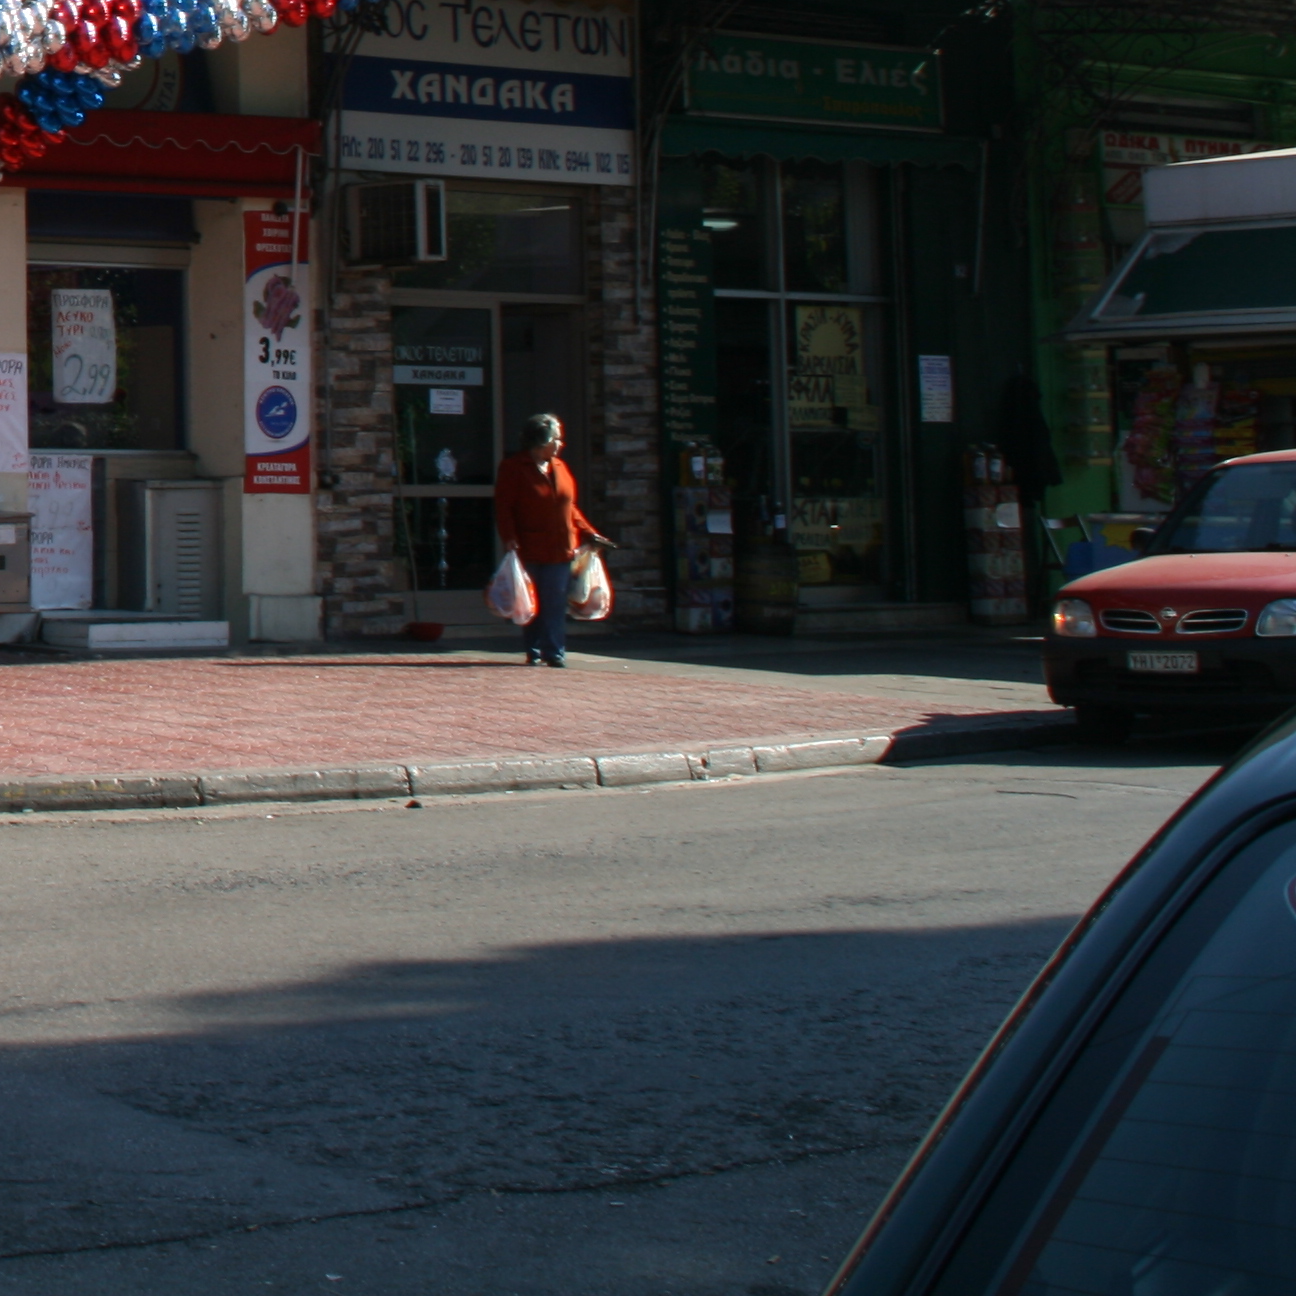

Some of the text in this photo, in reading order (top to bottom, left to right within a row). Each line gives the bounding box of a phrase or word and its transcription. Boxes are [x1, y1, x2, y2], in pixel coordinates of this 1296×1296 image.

[439, 2, 626, 56] ΤΕΛΕΤΩΝ
[698, 46, 800, 79] Λάδια
[836, 58, 928, 95] Ελιές
[390, 69, 576, 113] ΧΑΝΔΑΚΑ
[338, 135, 362, 158] ΗΛ:
[368, 137, 384, 159] 210
[391, 139, 400, 161] 51
[407, 140, 419, 162] 22
[425, 141, 445, 163] 296
[460, 144, 477, 165] 210
[482, 146, 492, 167] 51
[498, 146, 511, 167] 20
[517, 147, 533, 169] 139
[566, 150, 590, 172] 6944
[596, 151, 611, 173] 102
[1104, 133, 1242, 154] ΩΔΙΚΑ ΠΤΗΝΑ
[53, 294, 109, 308] ΠΡΟΣΦΟΡΑ
[56, 311, 94, 323] ΛΕΥΚΟ
[56, 324, 84, 336] ΤΥΡΙ
[259, 337, 296, 366] 3,99€
[61, 354, 110, 396] 2,99
[272, 370, 280, 380] ΤΟ
[412, 369, 466, 380] ΧΑΝΔΑΚΑ
